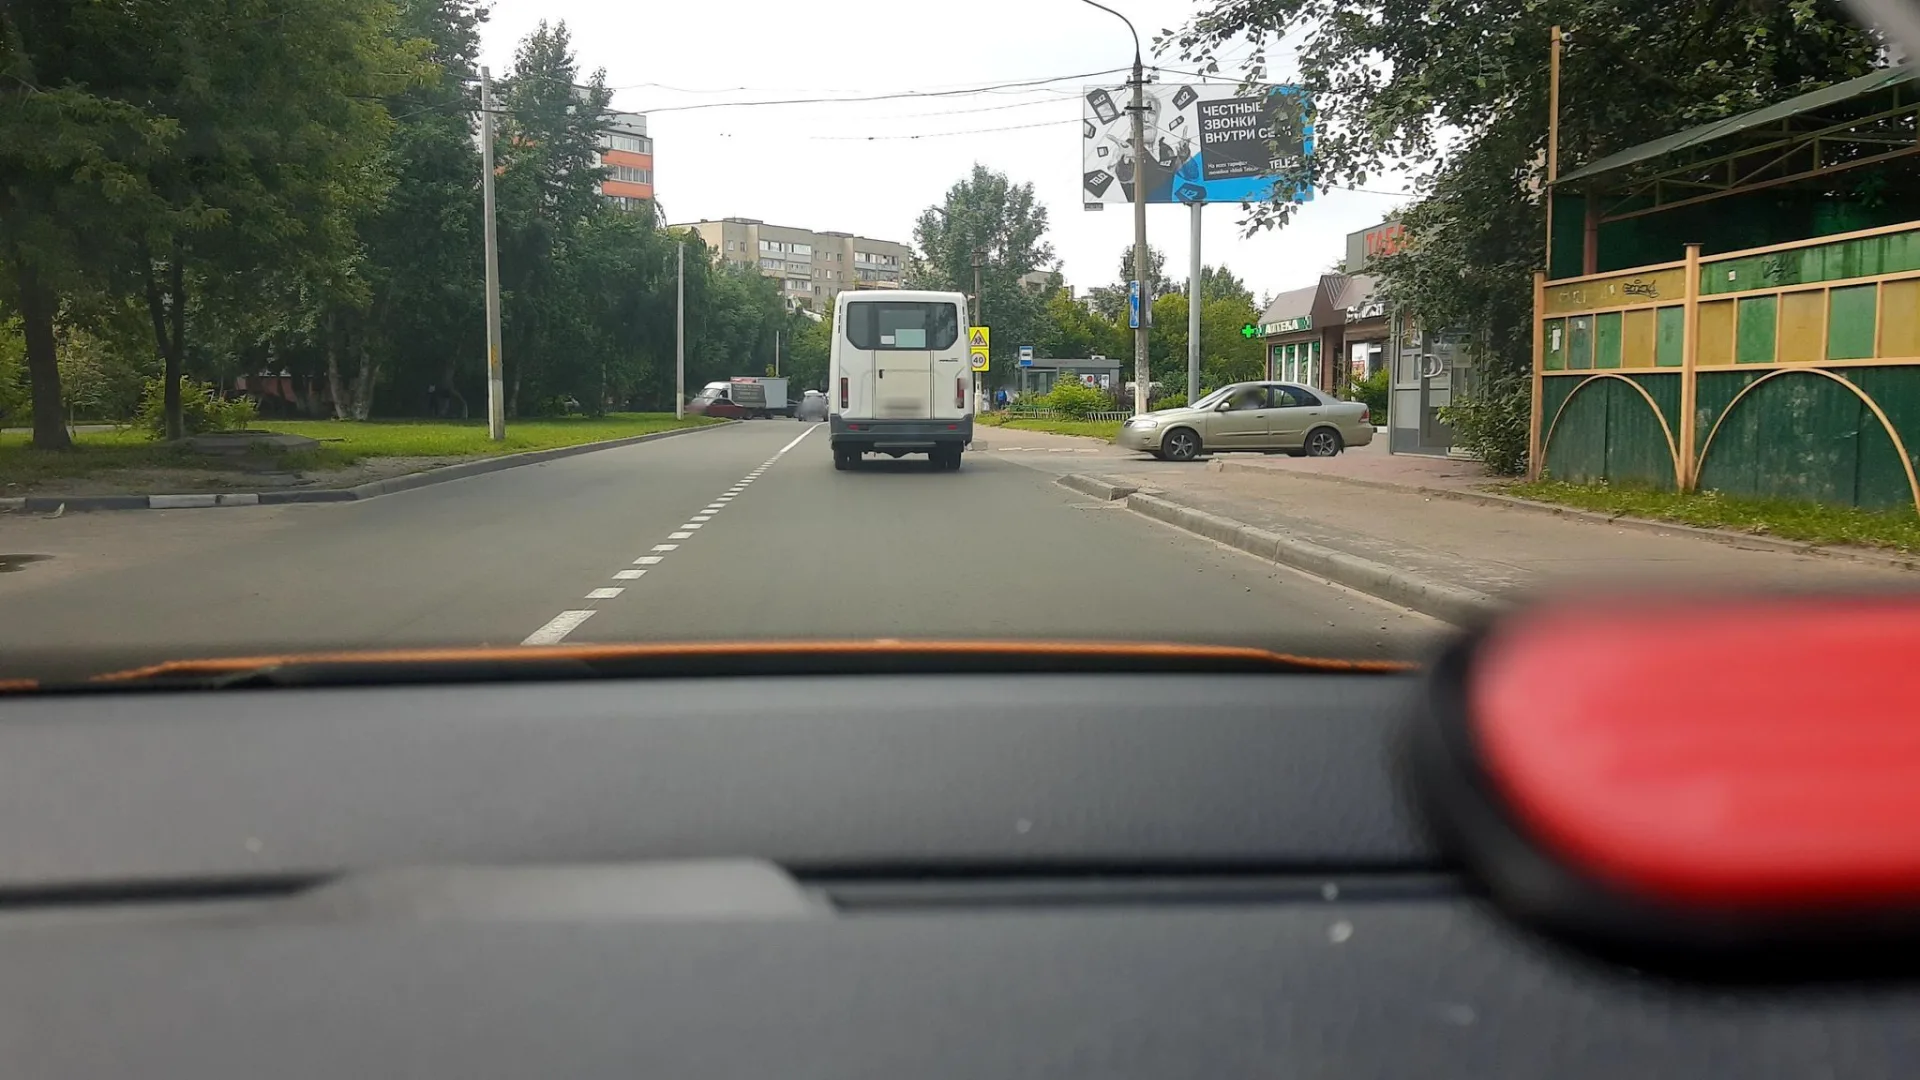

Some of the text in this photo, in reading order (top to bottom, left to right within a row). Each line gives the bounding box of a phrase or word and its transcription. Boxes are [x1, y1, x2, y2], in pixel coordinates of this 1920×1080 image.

[1202, 101, 1264, 117] ЧЕСТНЫЕ
[1204, 115, 1257, 130] ЗВОНКИ
[1204, 129, 1256, 144] ВНУТРИ
[1366, 223, 1411, 256] ТАБА
[1265, 319, 1298, 335] АПТЕКА
